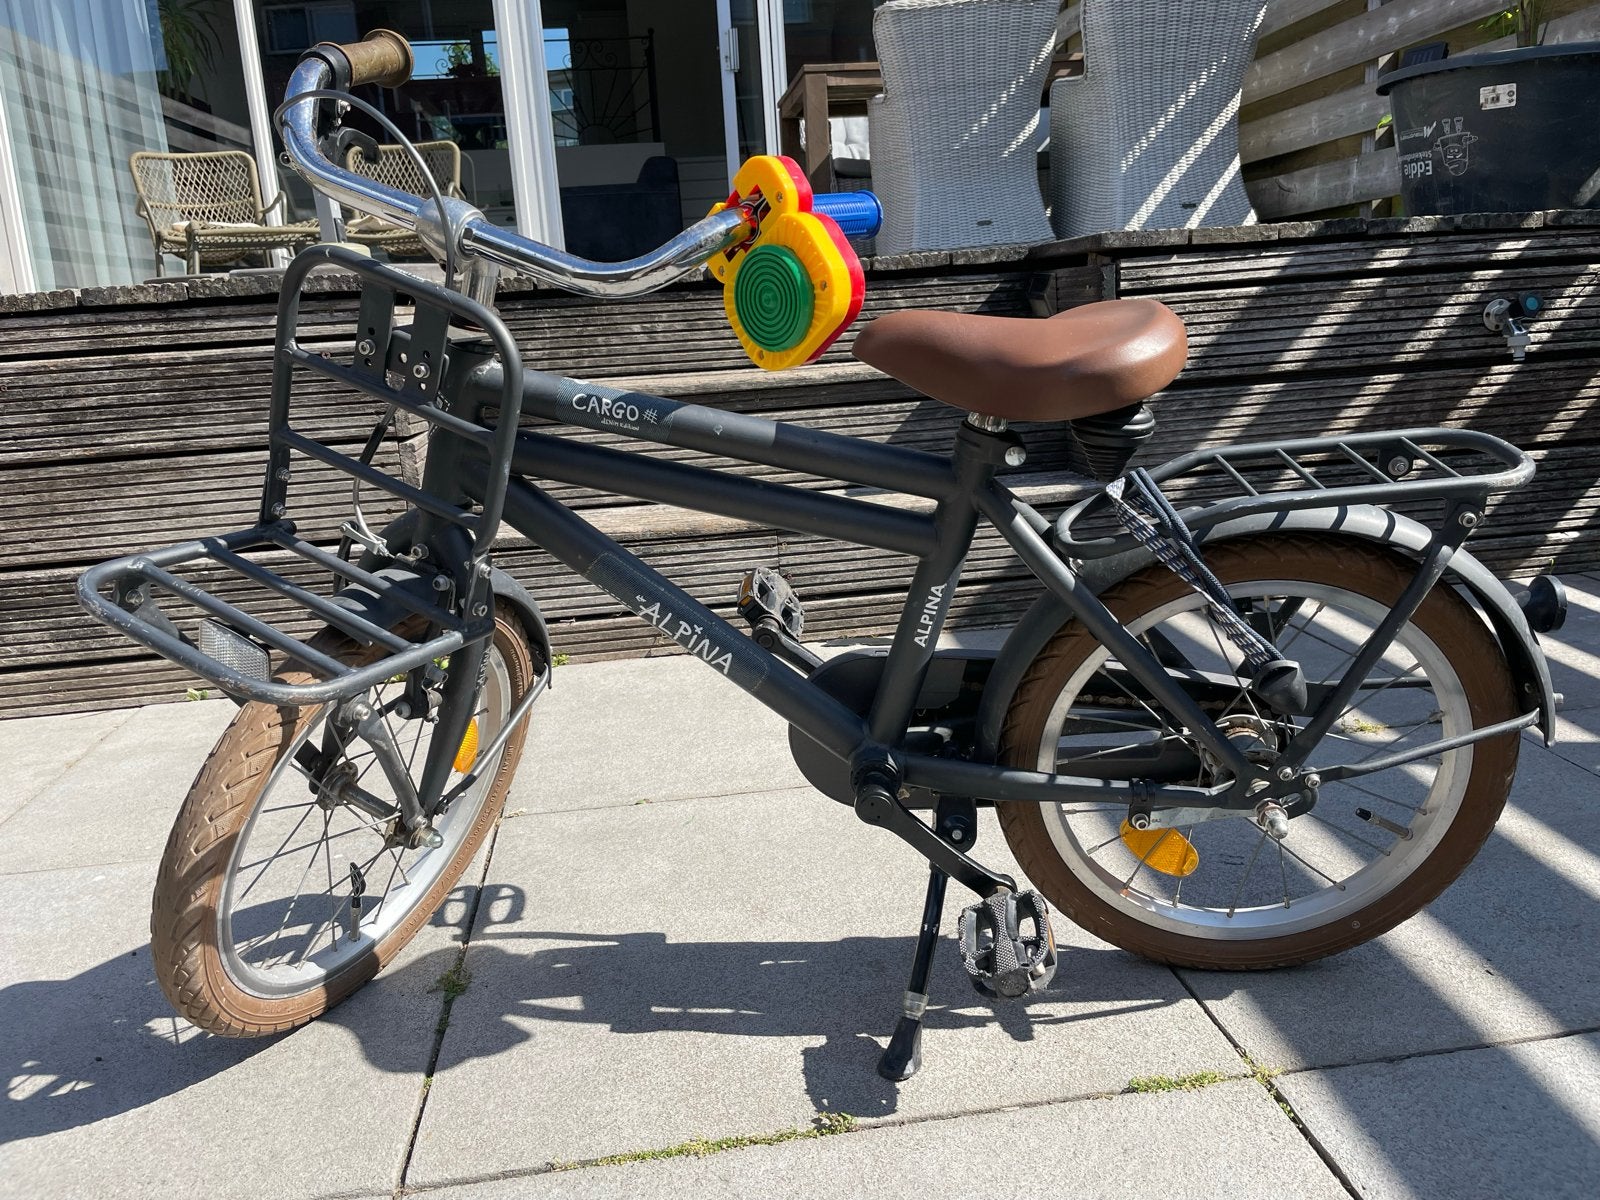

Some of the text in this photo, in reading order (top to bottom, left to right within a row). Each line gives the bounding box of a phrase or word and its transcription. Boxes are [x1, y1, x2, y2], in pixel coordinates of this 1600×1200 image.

[1403, 160, 1433, 179] Eddie
[572, 393, 639, 422] CARGO
[913, 582, 948, 648] ALPINA
